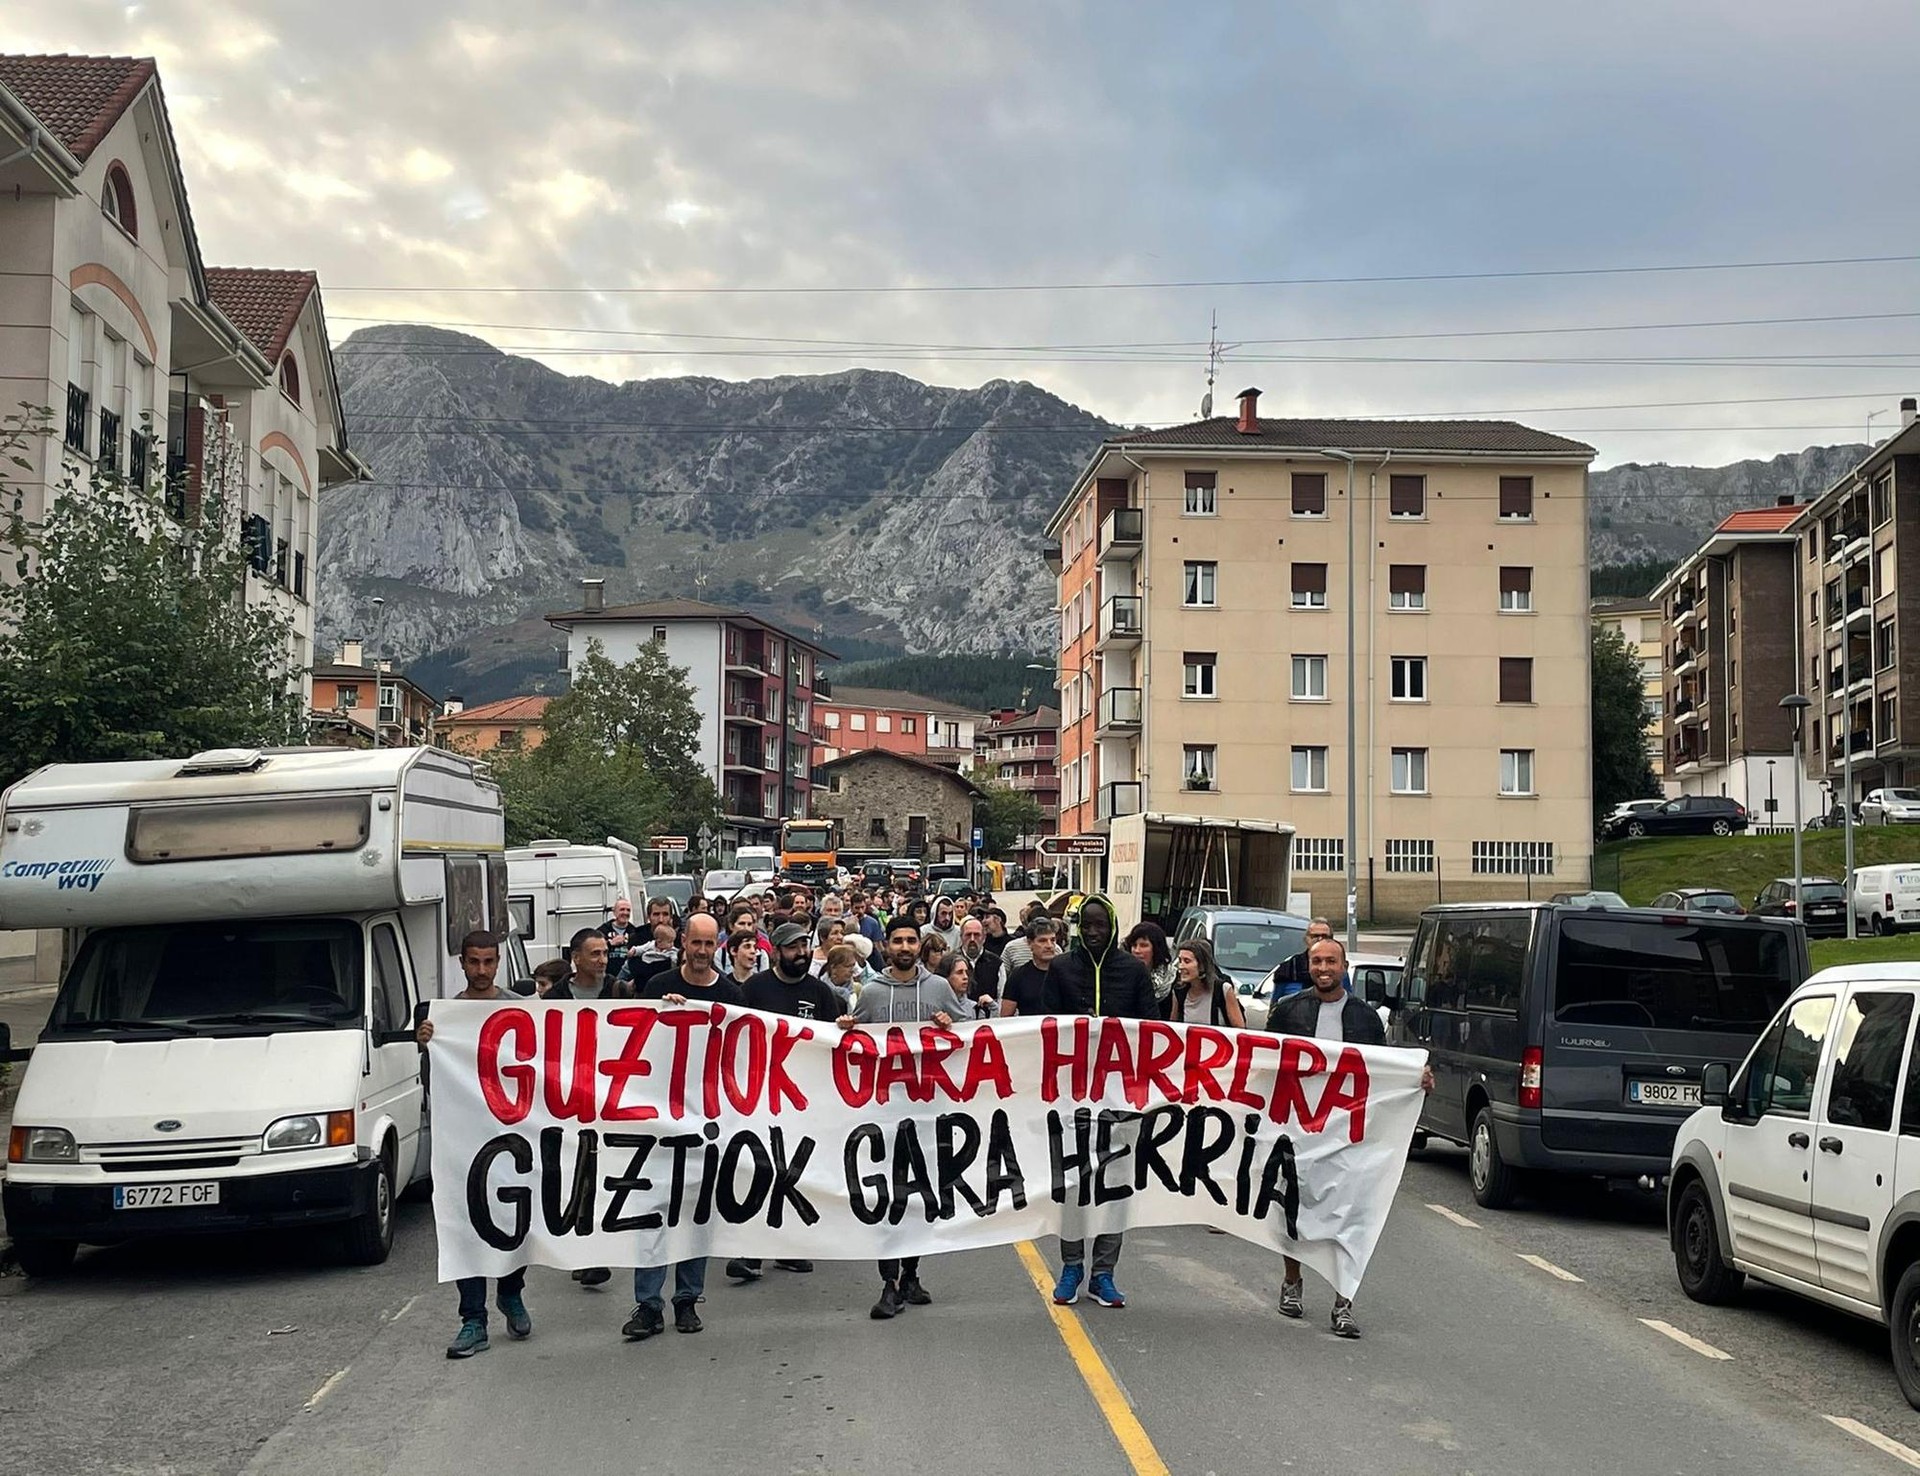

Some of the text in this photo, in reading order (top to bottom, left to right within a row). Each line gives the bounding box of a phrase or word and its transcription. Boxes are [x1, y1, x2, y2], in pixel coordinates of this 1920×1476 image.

[58, 873, 105, 892] way
[831, 1024, 1016, 1109] GARA
[1040, 1016, 1371, 1144] HARRERA
[1643, 1084, 1701, 1101] 9802 FK
[843, 1107, 1027, 1227] GARA
[126, 1184, 215, 1206] 6772 FCF
